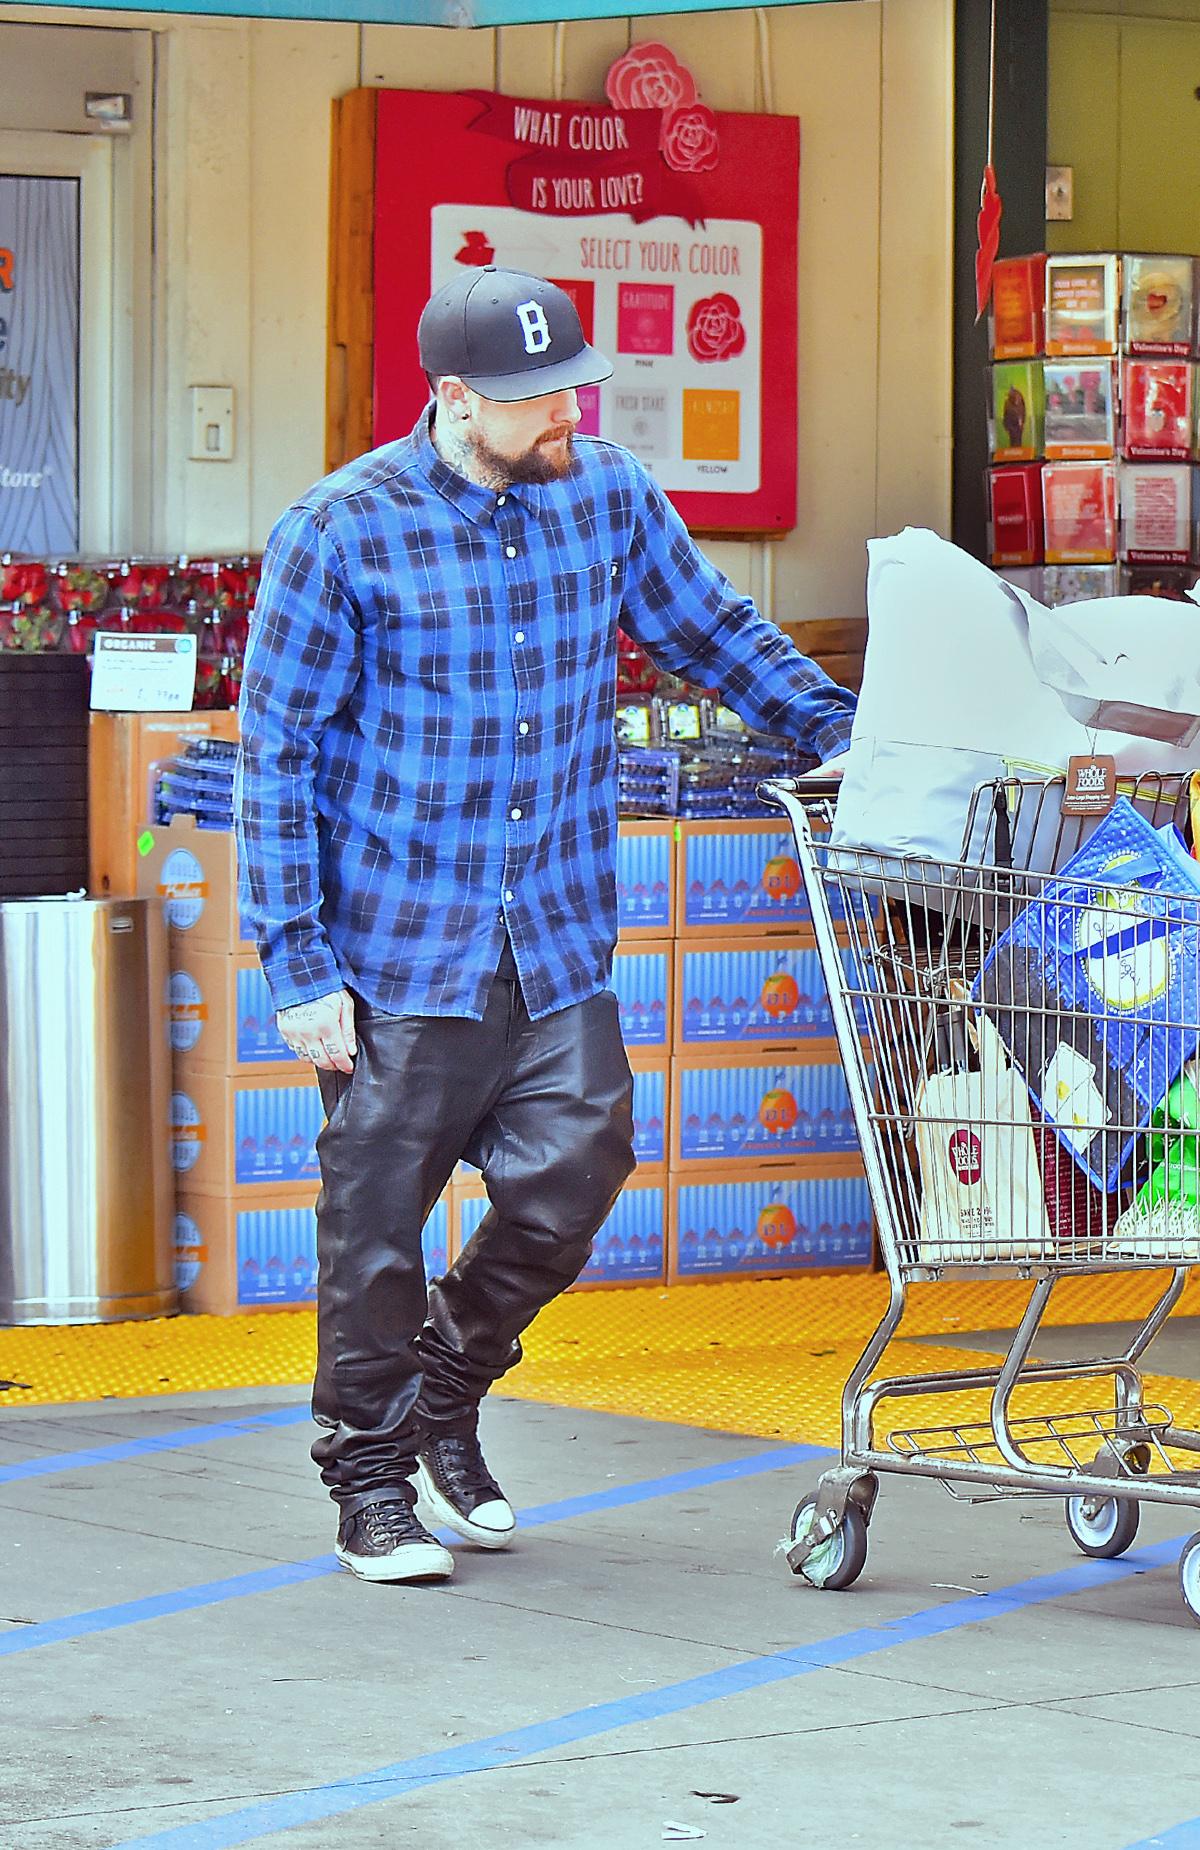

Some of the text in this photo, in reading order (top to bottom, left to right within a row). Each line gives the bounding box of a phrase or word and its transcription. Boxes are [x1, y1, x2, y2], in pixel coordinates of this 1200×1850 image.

[514, 106, 630, 151] WHAT COLOR
[532, 173, 645, 209] IS YOUR LOVE?
[580, 237, 741, 276] SELECT YOUR COLOR
[516, 300, 552, 354] B
[1131, 342, 1173, 355] Valentine's
[1130, 446, 1171, 458] Valentine's
[696, 464, 729, 474] YELLOW
[1130, 551, 1171, 562] Valentine's
[103, 639, 156, 650] ORGANIC
[1077, 768, 1107, 779] WHOLE
[1077, 778, 1105, 787] FOODS
